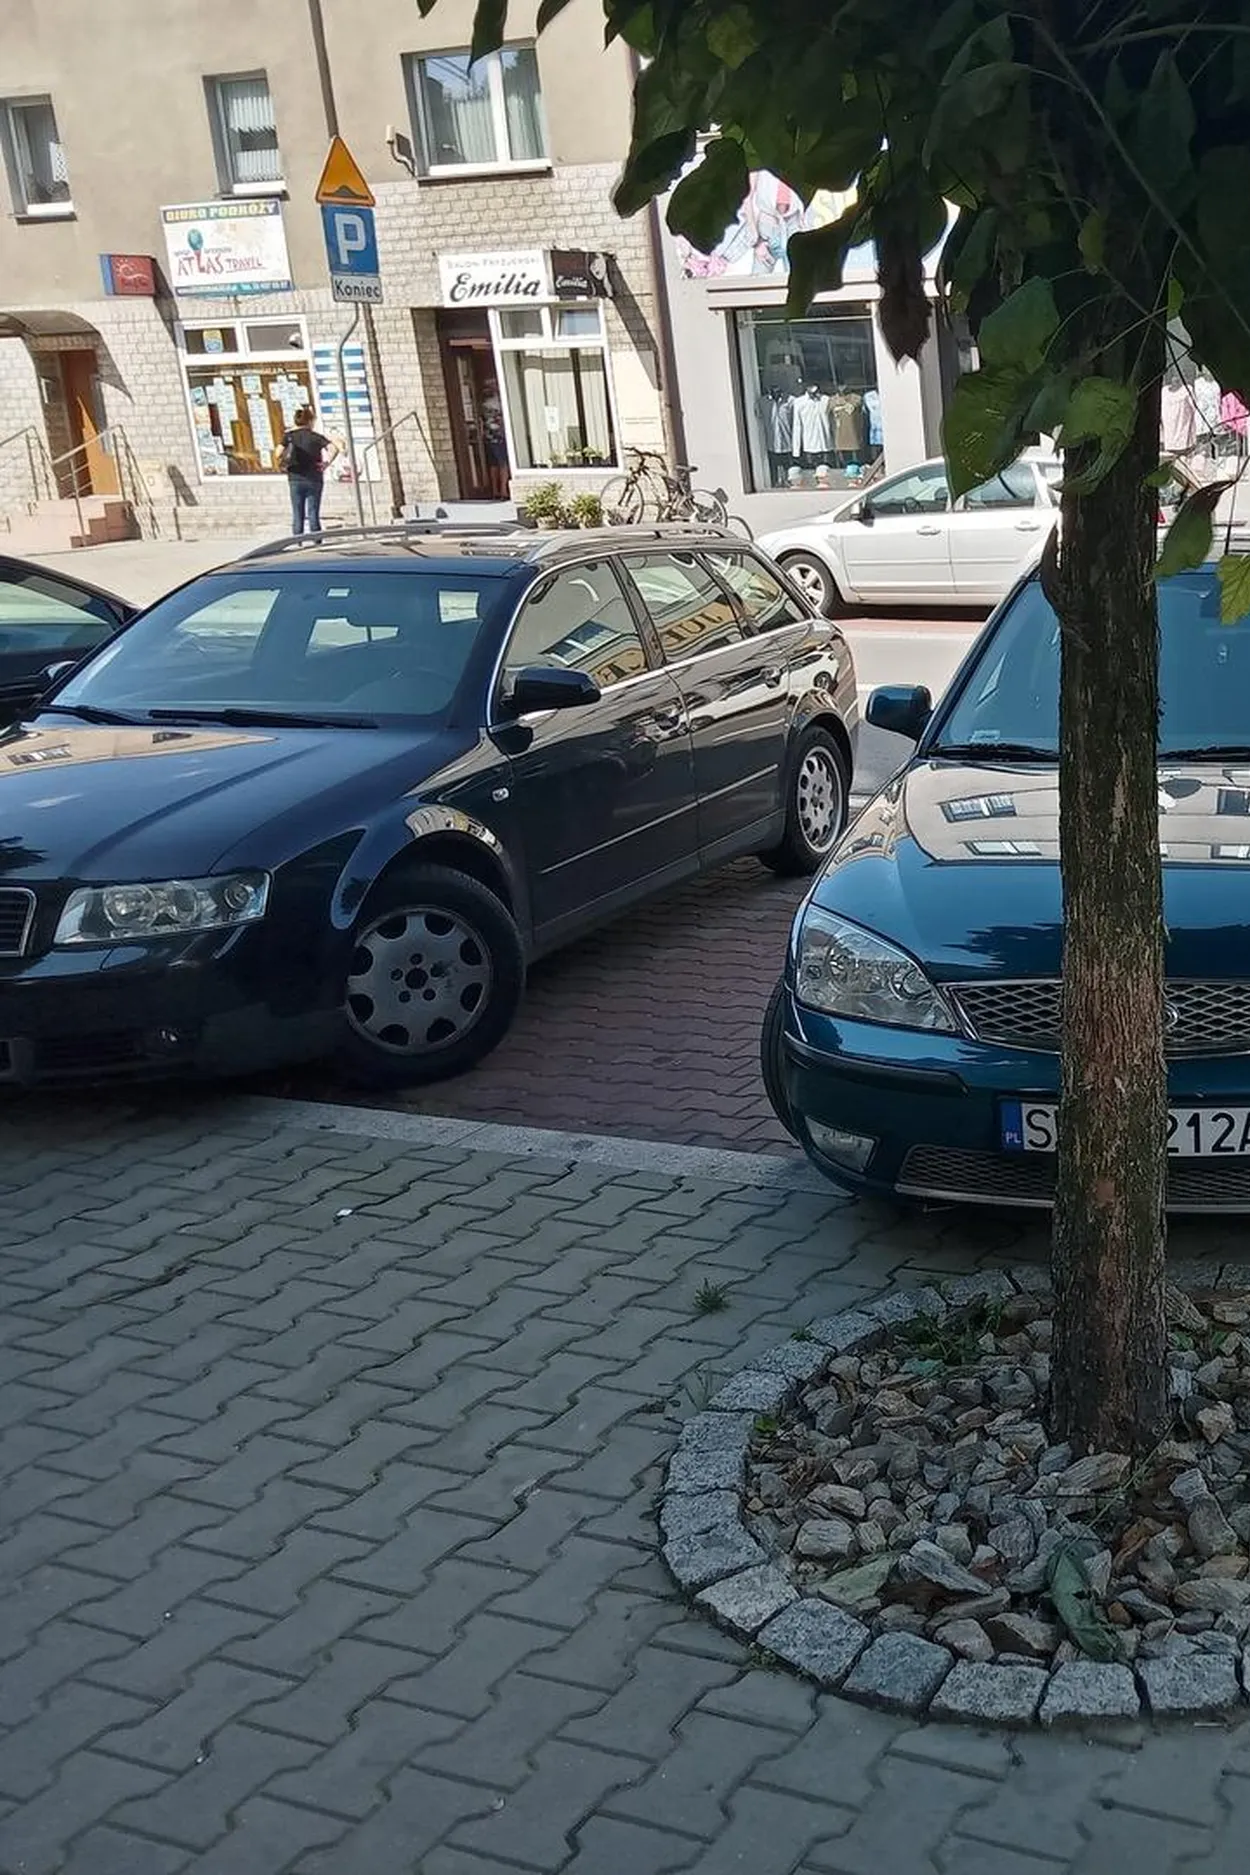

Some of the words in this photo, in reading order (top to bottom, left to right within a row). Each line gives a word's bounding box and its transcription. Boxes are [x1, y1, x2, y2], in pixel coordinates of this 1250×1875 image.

[166, 207, 207, 222] BIURO
[334, 213, 367, 264] P
[177, 250, 223, 276] ATLAS
[225, 257, 263, 273] TRAVEL
[334, 280, 380, 298] Koniec
[450, 272, 541, 302] Emilia
[1006, 1131, 1022, 1144] PL
